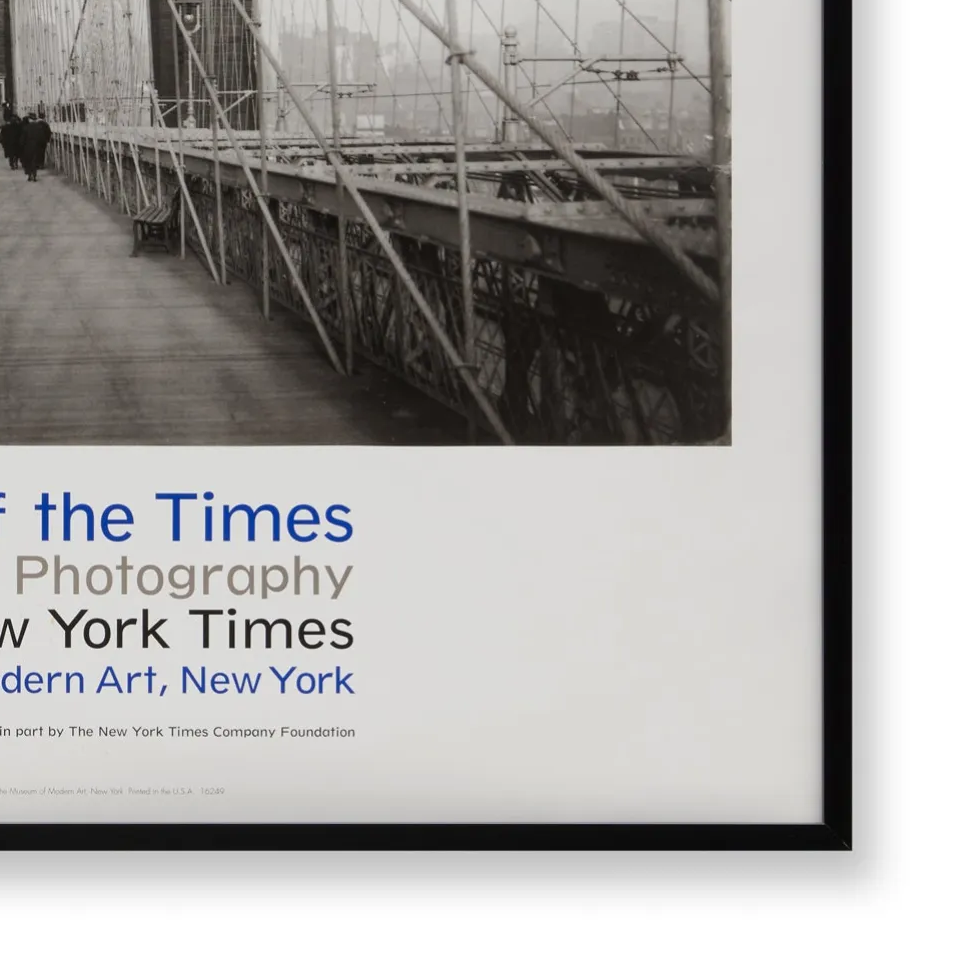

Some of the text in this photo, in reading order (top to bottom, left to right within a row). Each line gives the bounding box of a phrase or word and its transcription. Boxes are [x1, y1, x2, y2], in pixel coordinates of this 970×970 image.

[34, 492, 135, 542] the
[154, 491, 354, 542] Times
[16, 555, 354, 600] Photography
[47, 608, 171, 649] York
[188, 608, 354, 649] Times
[95, 666, 168, 697] Art,
[181, 666, 263, 694] New
[268, 665, 356, 694] York
[0, 726, 11, 737] in
[15, 726, 44, 739] part
[48, 726, 64, 740] by
[68, 726, 94, 738] The
[98, 726, 128, 738] New
[132, 726, 164, 738] York
[168, 726, 209, 738] Times
[213, 726, 276, 740] Company
[280, 726, 356, 738] Foundation
[10, 787, 37, 796] Museum
[39, 786, 47, 796] of
[48, 787, 75, 796] Modern
[90, 787, 108, 796] New
[129, 786, 150, 796] Printed
[152, 787, 159, 796] in
[160, 787, 171, 796] the
[199, 786, 226, 796] 16249
